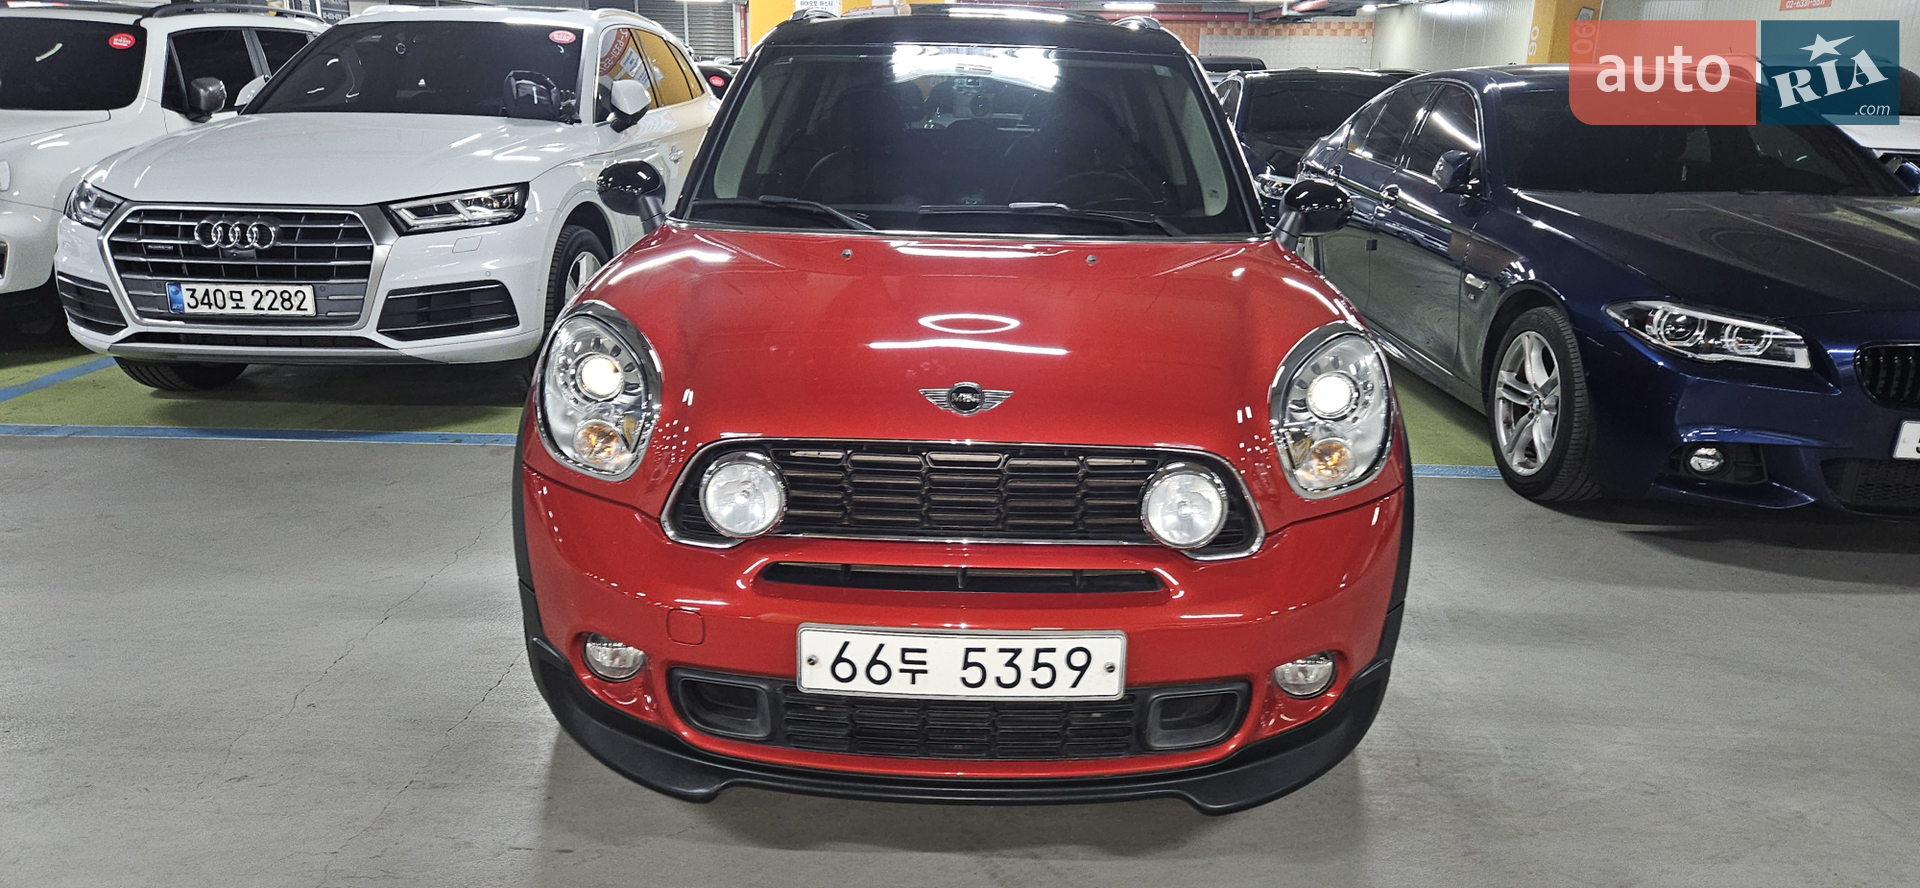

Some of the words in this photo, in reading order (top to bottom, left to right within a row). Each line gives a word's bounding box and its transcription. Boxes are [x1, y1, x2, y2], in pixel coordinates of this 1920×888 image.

[185, 288, 246, 310] 340모
[251, 289, 308, 312] 2282
[951, 392, 981, 403] MINI
[830, 641, 928, 685] 66두
[960, 646, 1093, 690] 5359
